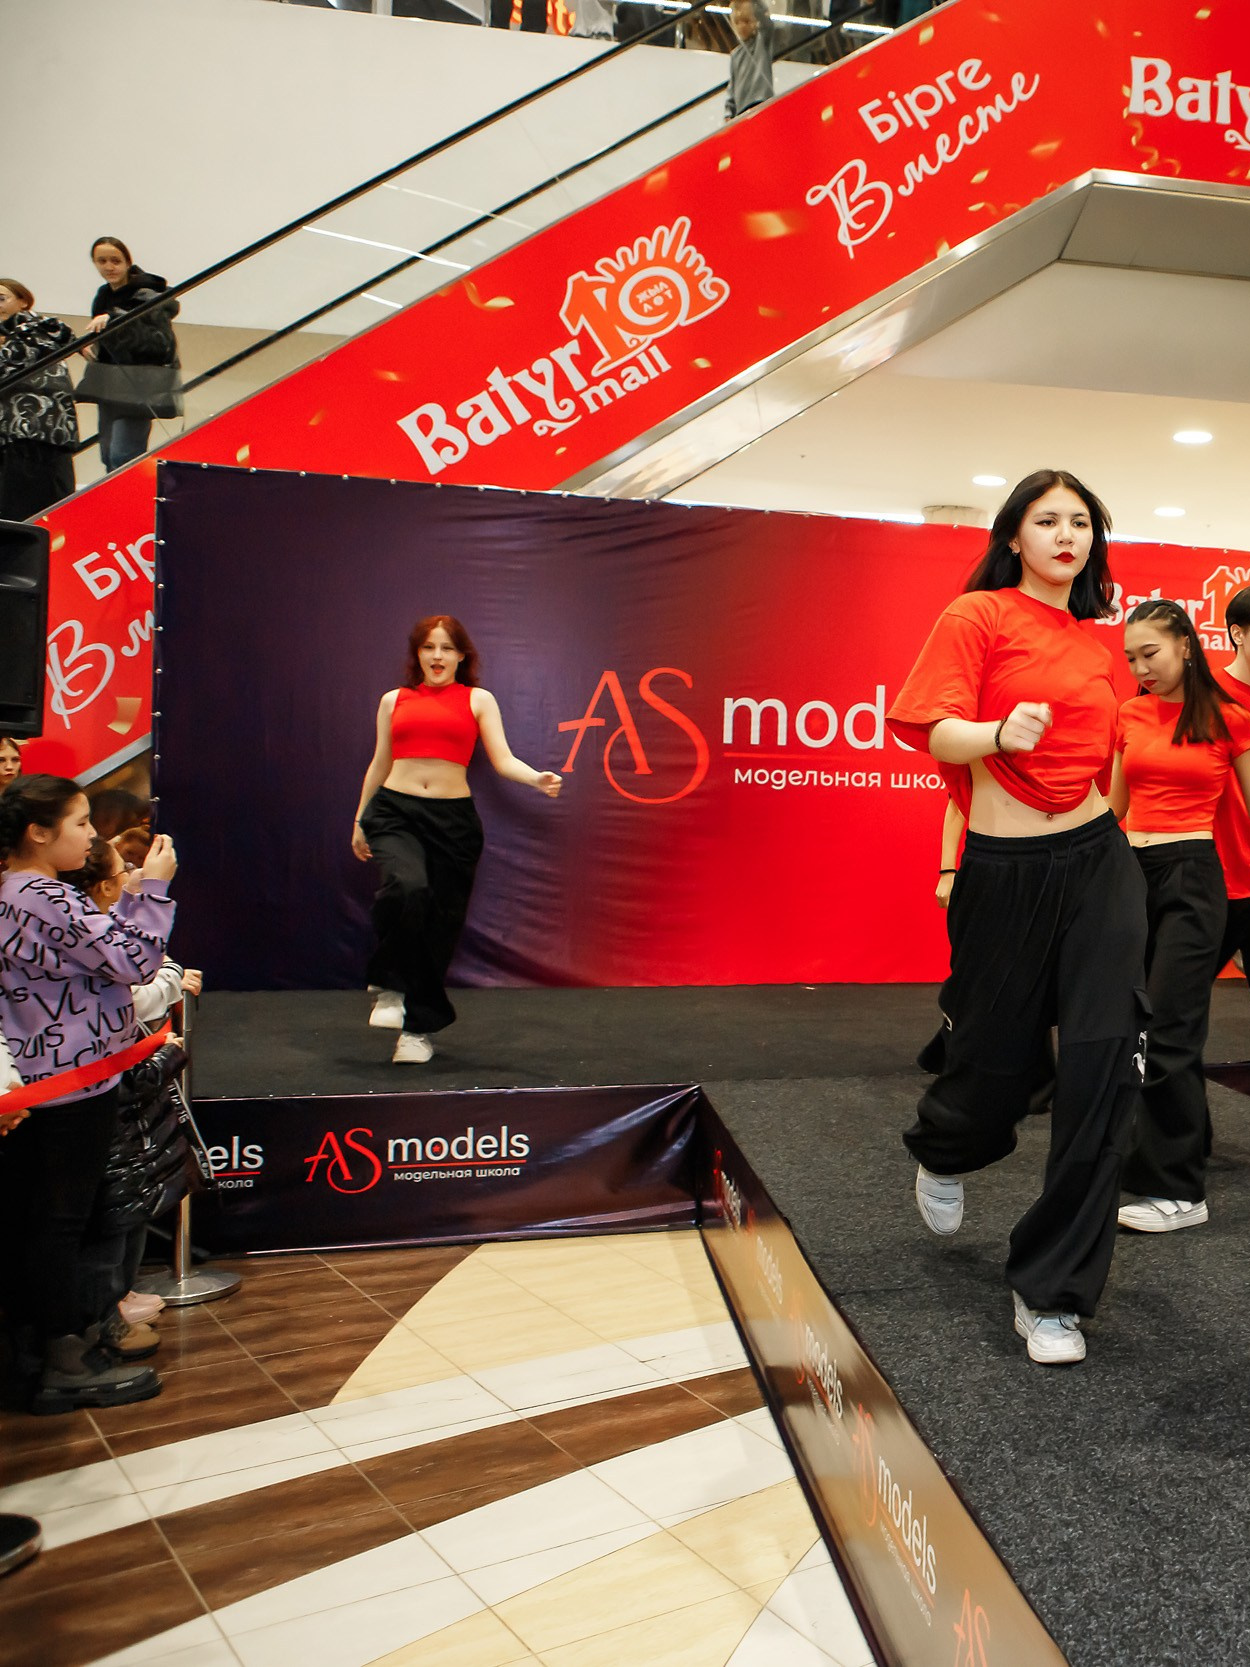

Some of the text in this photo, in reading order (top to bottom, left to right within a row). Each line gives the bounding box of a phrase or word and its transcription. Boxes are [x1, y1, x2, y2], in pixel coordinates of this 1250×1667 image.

[858, 58, 992, 144] Бірге
[805, 71, 1040, 259] Вместе
[396, 339, 589, 475] Batyr
[578, 344, 672, 414] mall
[72, 533, 155, 600] Бір
[557, 666, 918, 805] AS mod
[733, 766, 947, 791] модельная шко
[206, 1135, 265, 1171] els
[217, 1179, 254, 1189] кола
[303, 1125, 531, 1195] AS models
[393, 1167, 521, 1183] модельная школа
[878, 1455, 937, 1596] models
